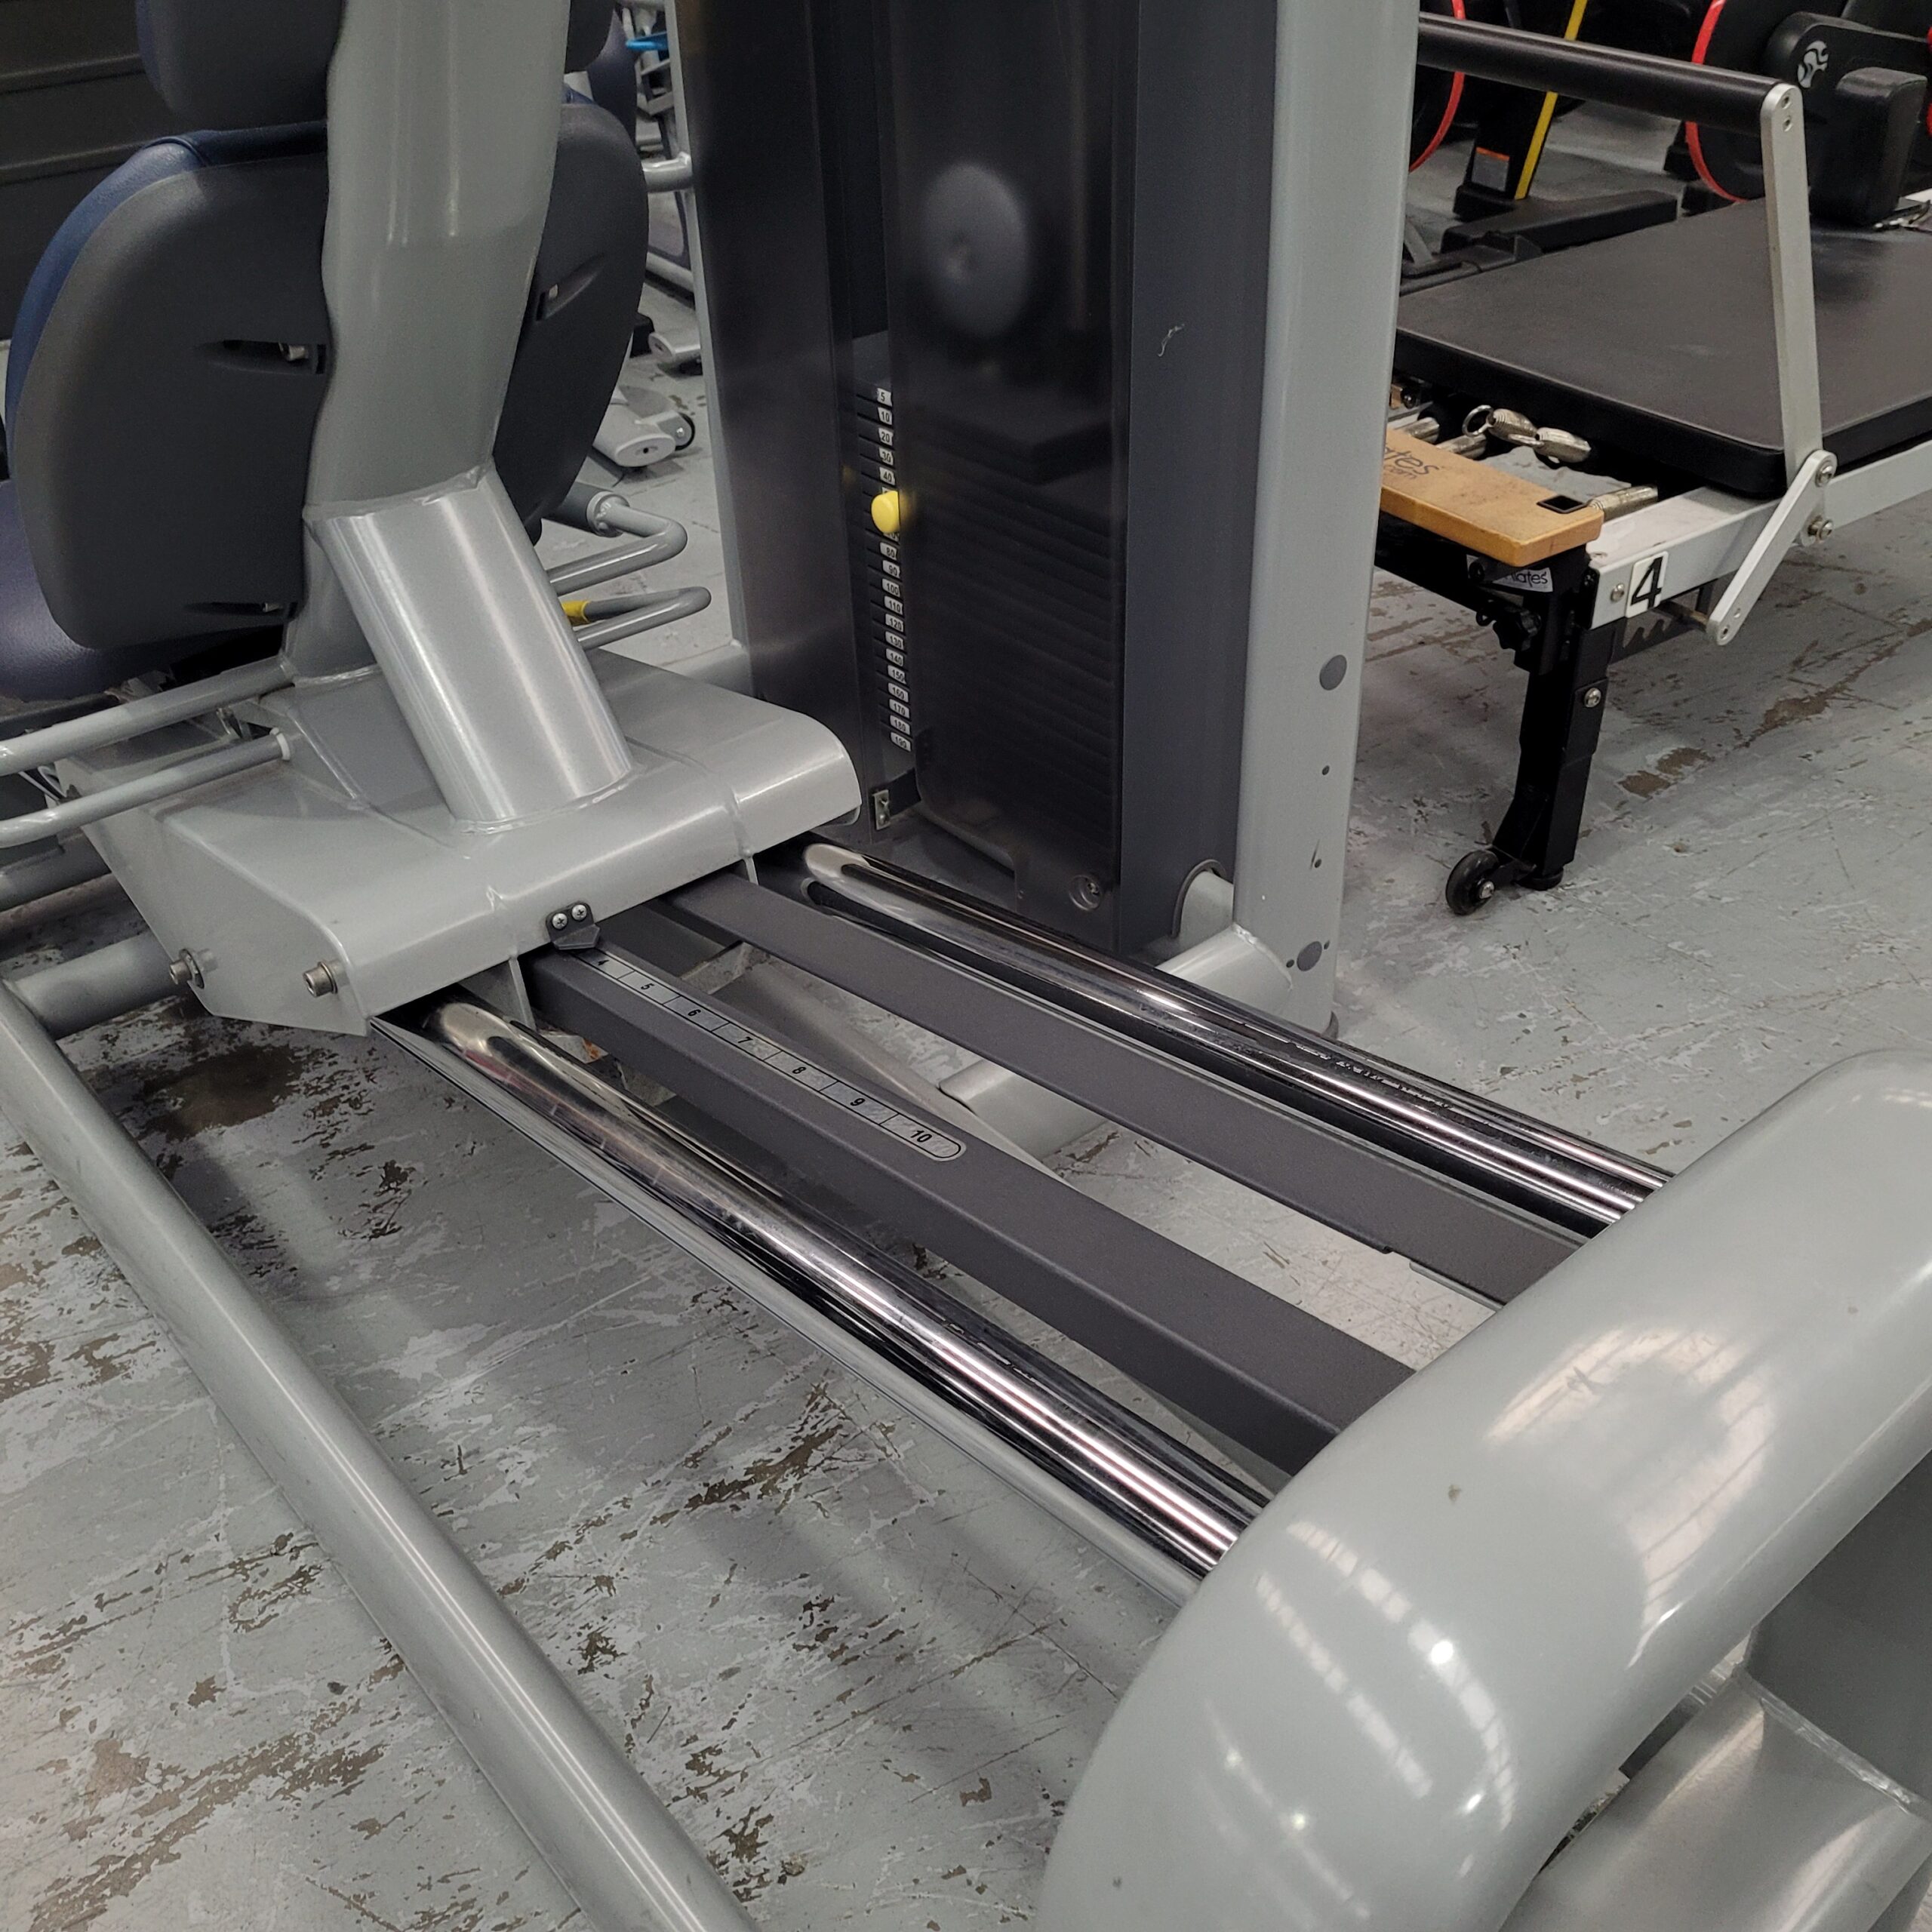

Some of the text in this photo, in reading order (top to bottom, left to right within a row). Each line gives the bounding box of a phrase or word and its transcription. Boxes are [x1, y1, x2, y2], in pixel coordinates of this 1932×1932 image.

[1631, 555, 1664, 610] 4
[688, 1008, 701, 1017] 6
[737, 1036, 753, 1045] 7
[792, 1066, 806, 1075] 8
[850, 1097, 866, 1107] 9
[910, 1130, 933, 1143] 10
